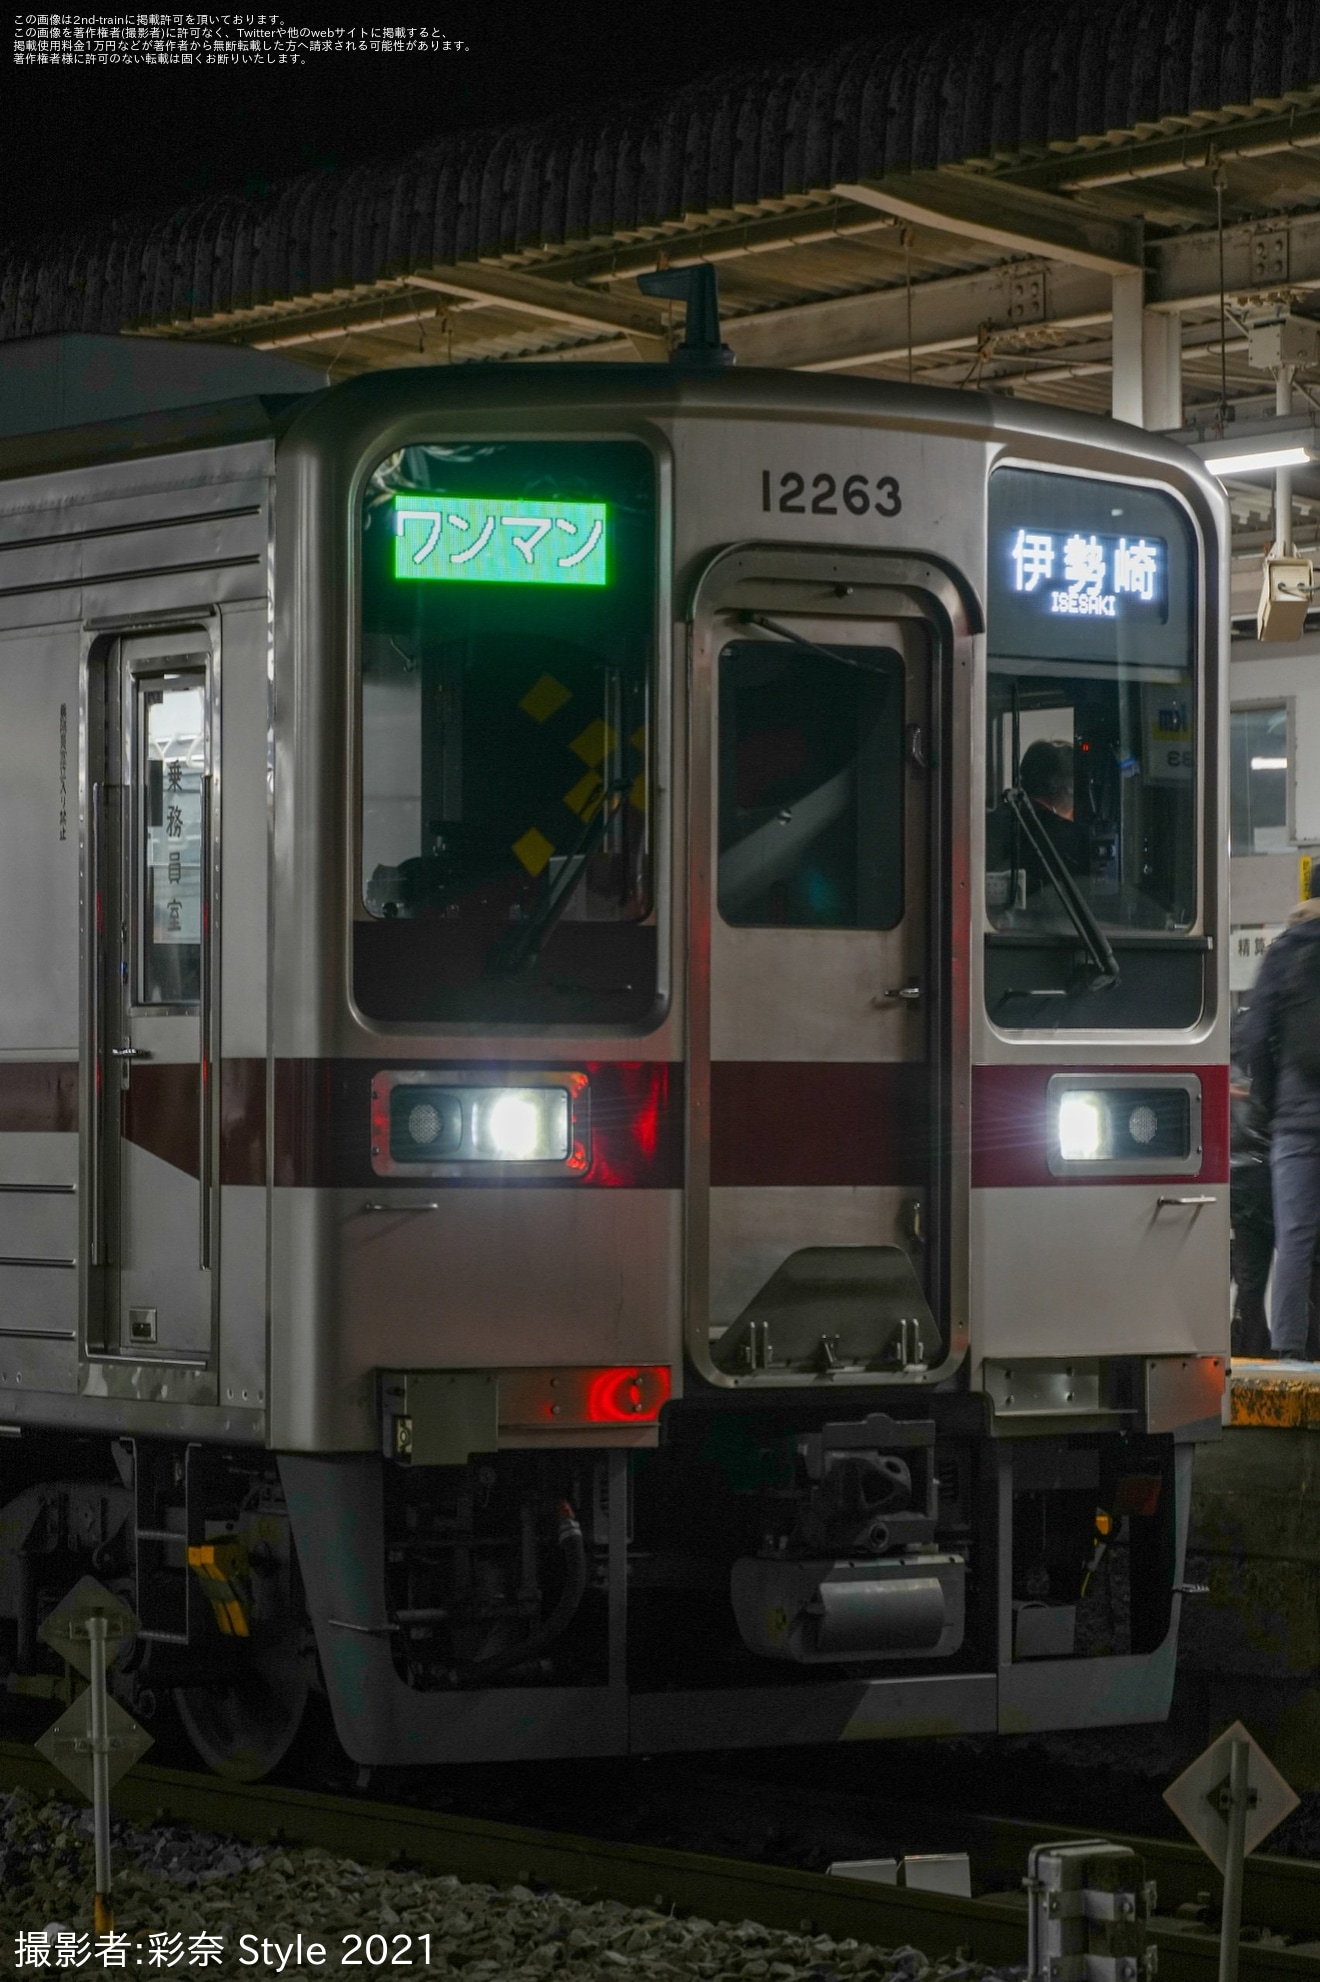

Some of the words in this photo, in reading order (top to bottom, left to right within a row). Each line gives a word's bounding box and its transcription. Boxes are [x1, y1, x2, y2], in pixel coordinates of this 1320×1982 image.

[762, 470, 902, 517] 12263
[396, 509, 604, 568] ワンマン
[1012, 529, 1157, 600] 伊勢崎
[1051, 591, 1116, 616] ISESAKI
[165, 759, 184, 932] 乗務員室
